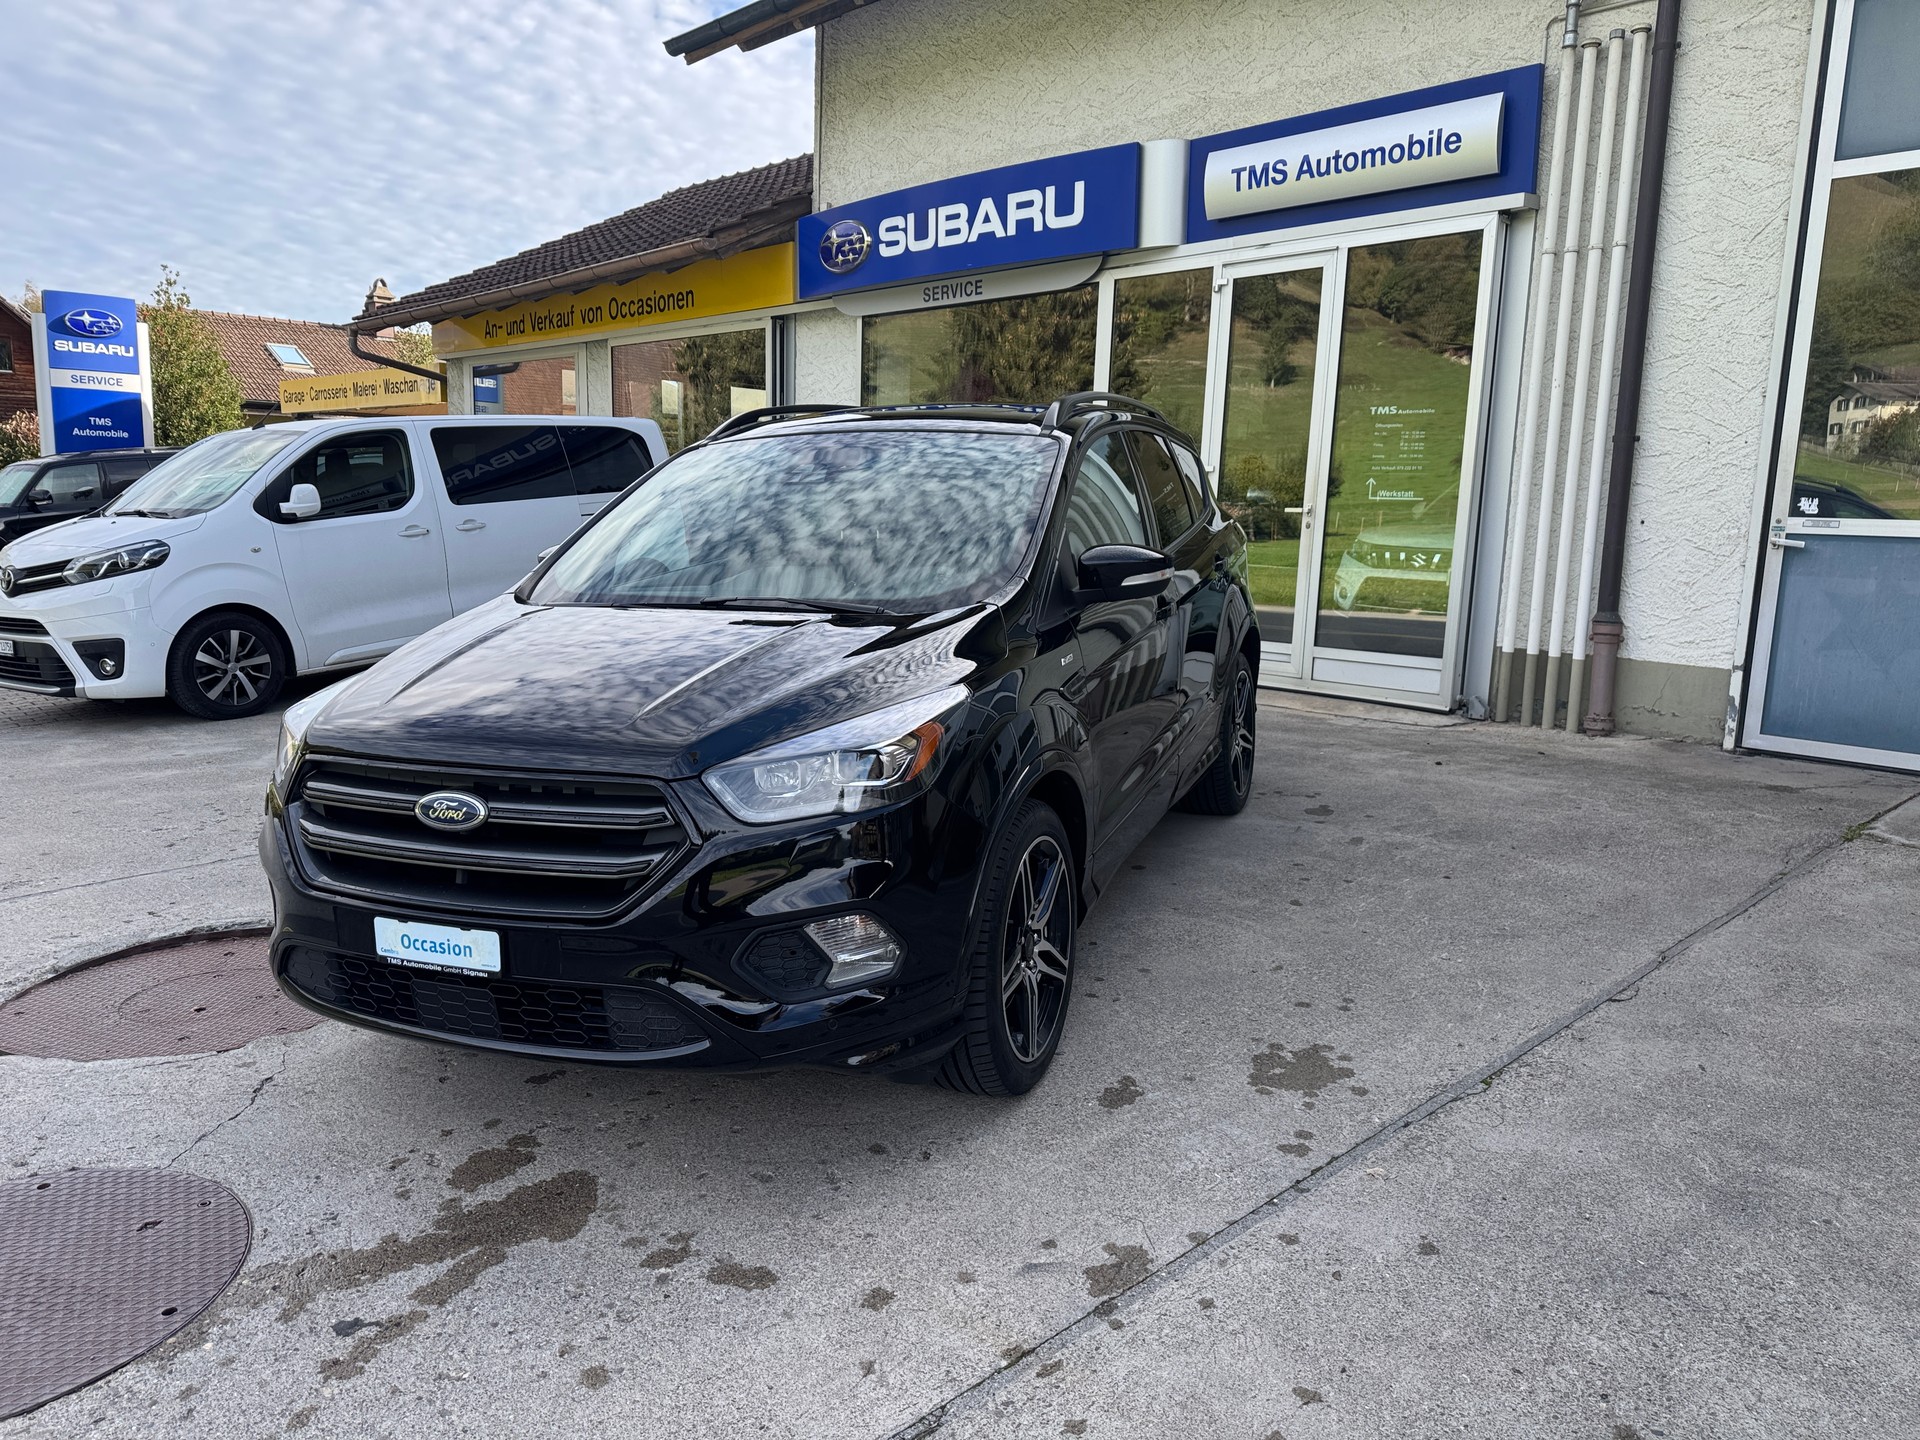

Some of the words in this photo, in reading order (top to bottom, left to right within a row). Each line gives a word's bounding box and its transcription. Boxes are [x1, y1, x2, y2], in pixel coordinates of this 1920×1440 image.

[1231, 158, 1288, 192] TMS
[1295, 128, 1462, 181] Automobile
[878, 180, 1085, 258] SUBARU
[923, 279, 983, 302] SERVICE
[484, 319, 503, 339] An-
[506, 314, 525, 336] und
[529, 304, 574, 332] Verkauf
[580, 305, 603, 324] von
[608, 289, 695, 320] Occasionen
[54, 339, 134, 357] SUBARU
[70, 374, 124, 387] SERVICE
[283, 389, 305, 405] Garage
[309, 383, 348, 402] Carrosserie
[352, 379, 378, 397] Malerei
[1370, 405, 1397, 415] TMS
[89, 417, 112, 426] TMS
[72, 427, 129, 439] Automobile
[1379, 489, 1414, 498] Werkstatt
[429, 799, 467, 820] Ford
[401, 933, 473, 958] Occasion
[386, 957, 402, 965] TMS
[402, 960, 442, 971] Automobile
[443, 966, 461, 974] GmbH
[462, 968, 488, 978] Signau
